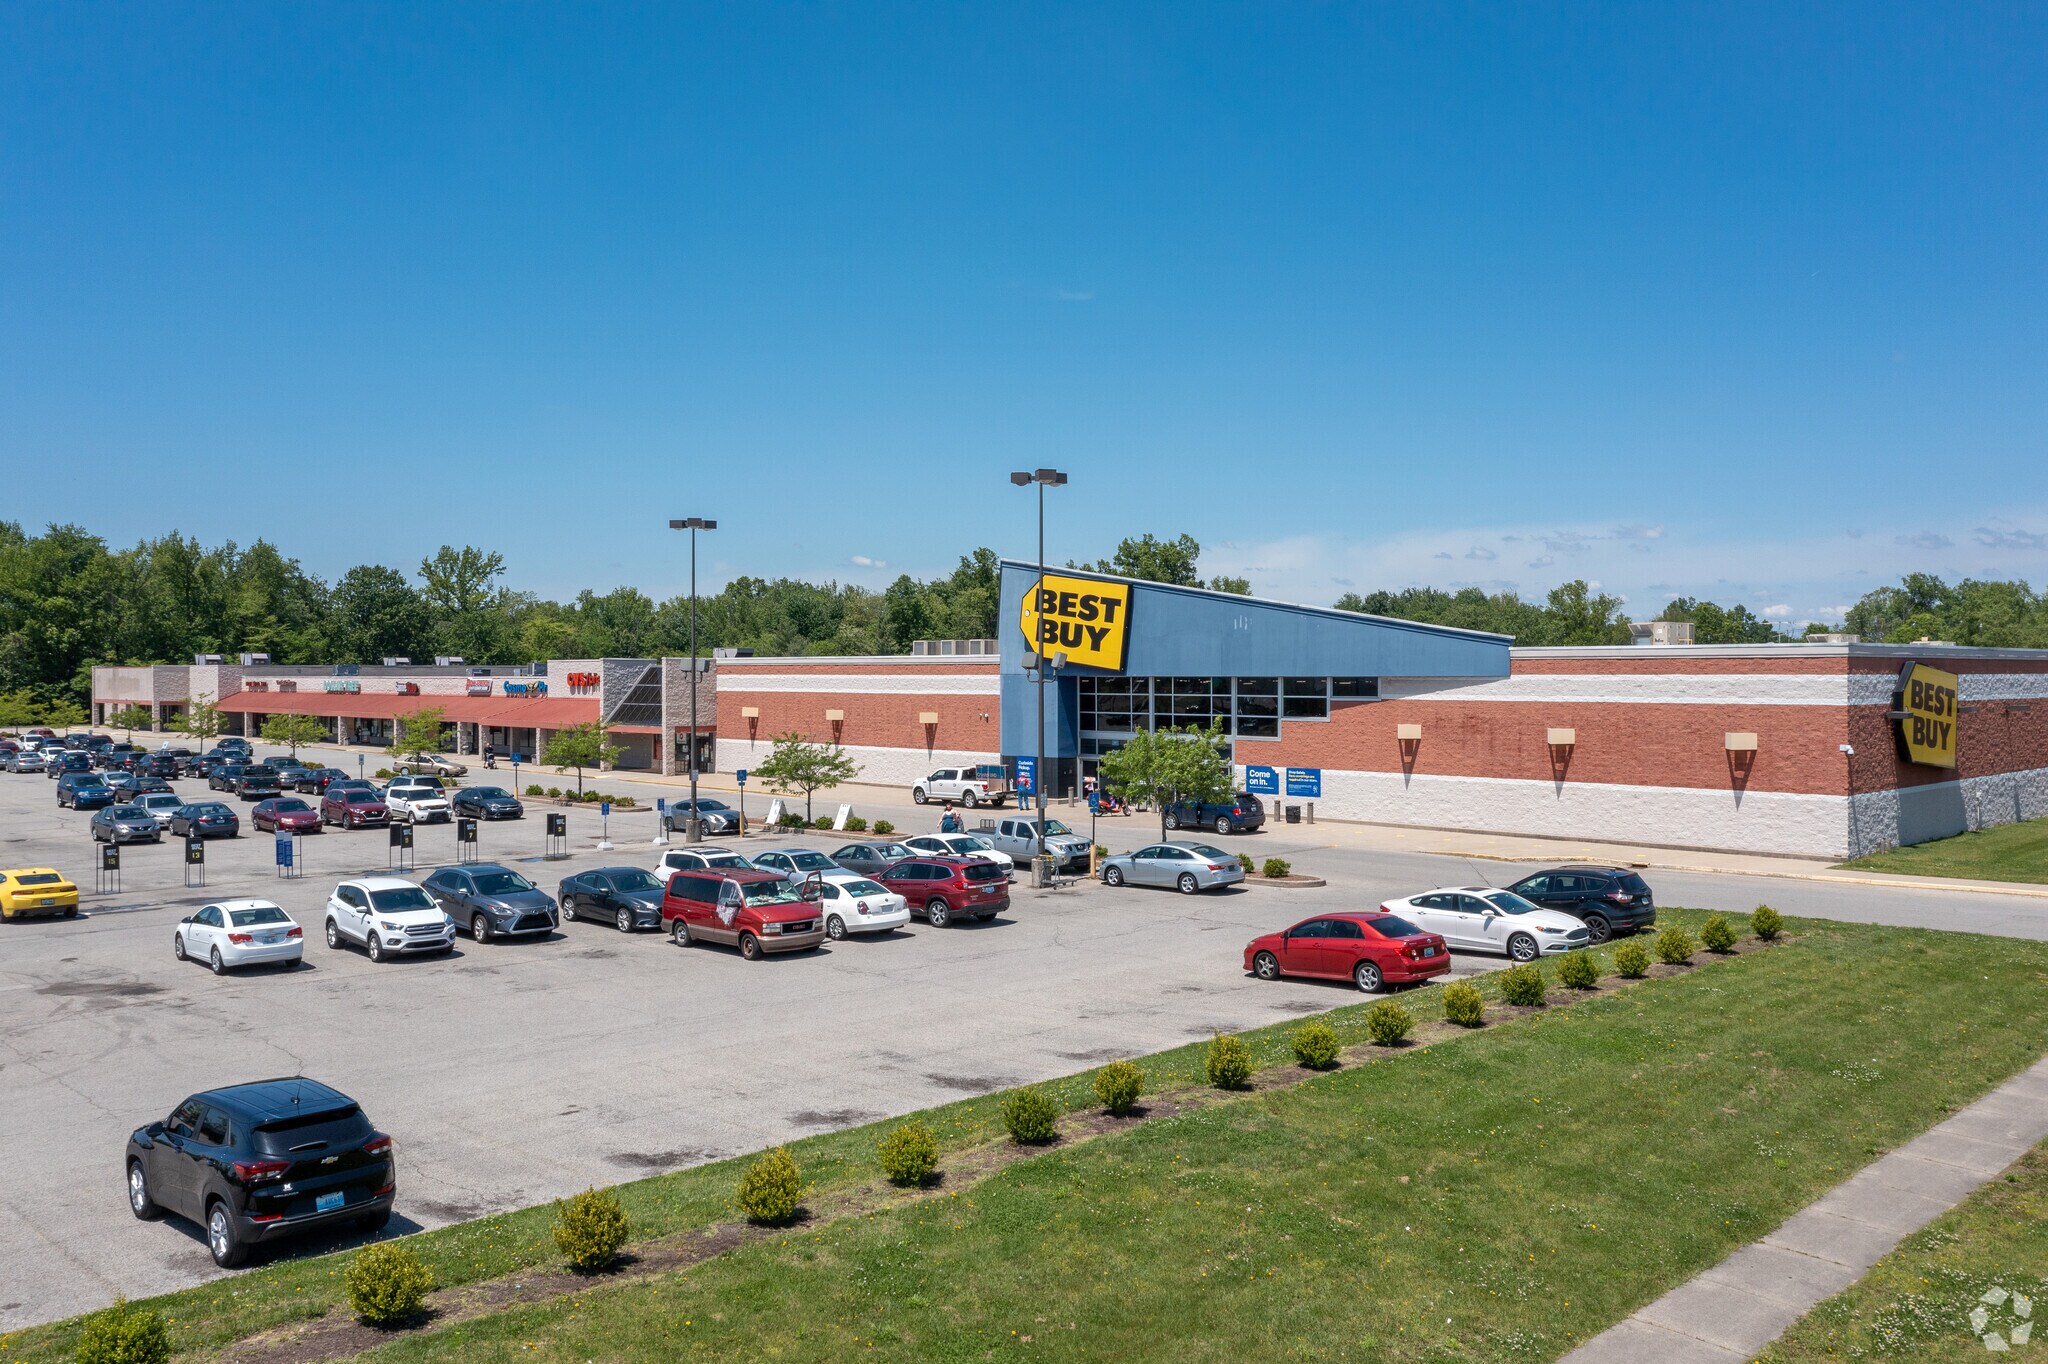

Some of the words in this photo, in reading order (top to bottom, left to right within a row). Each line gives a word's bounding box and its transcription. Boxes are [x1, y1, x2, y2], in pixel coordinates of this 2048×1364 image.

[1034, 588, 1122, 623] BEST
[1035, 618, 1111, 652] BUY
[503, 680, 527, 693] Cosmo
[1910, 679, 1956, 717] BEST
[1912, 716, 1952, 750] BUY
[1249, 769, 1271, 778] Come
[1259, 777, 1268, 786] in.
